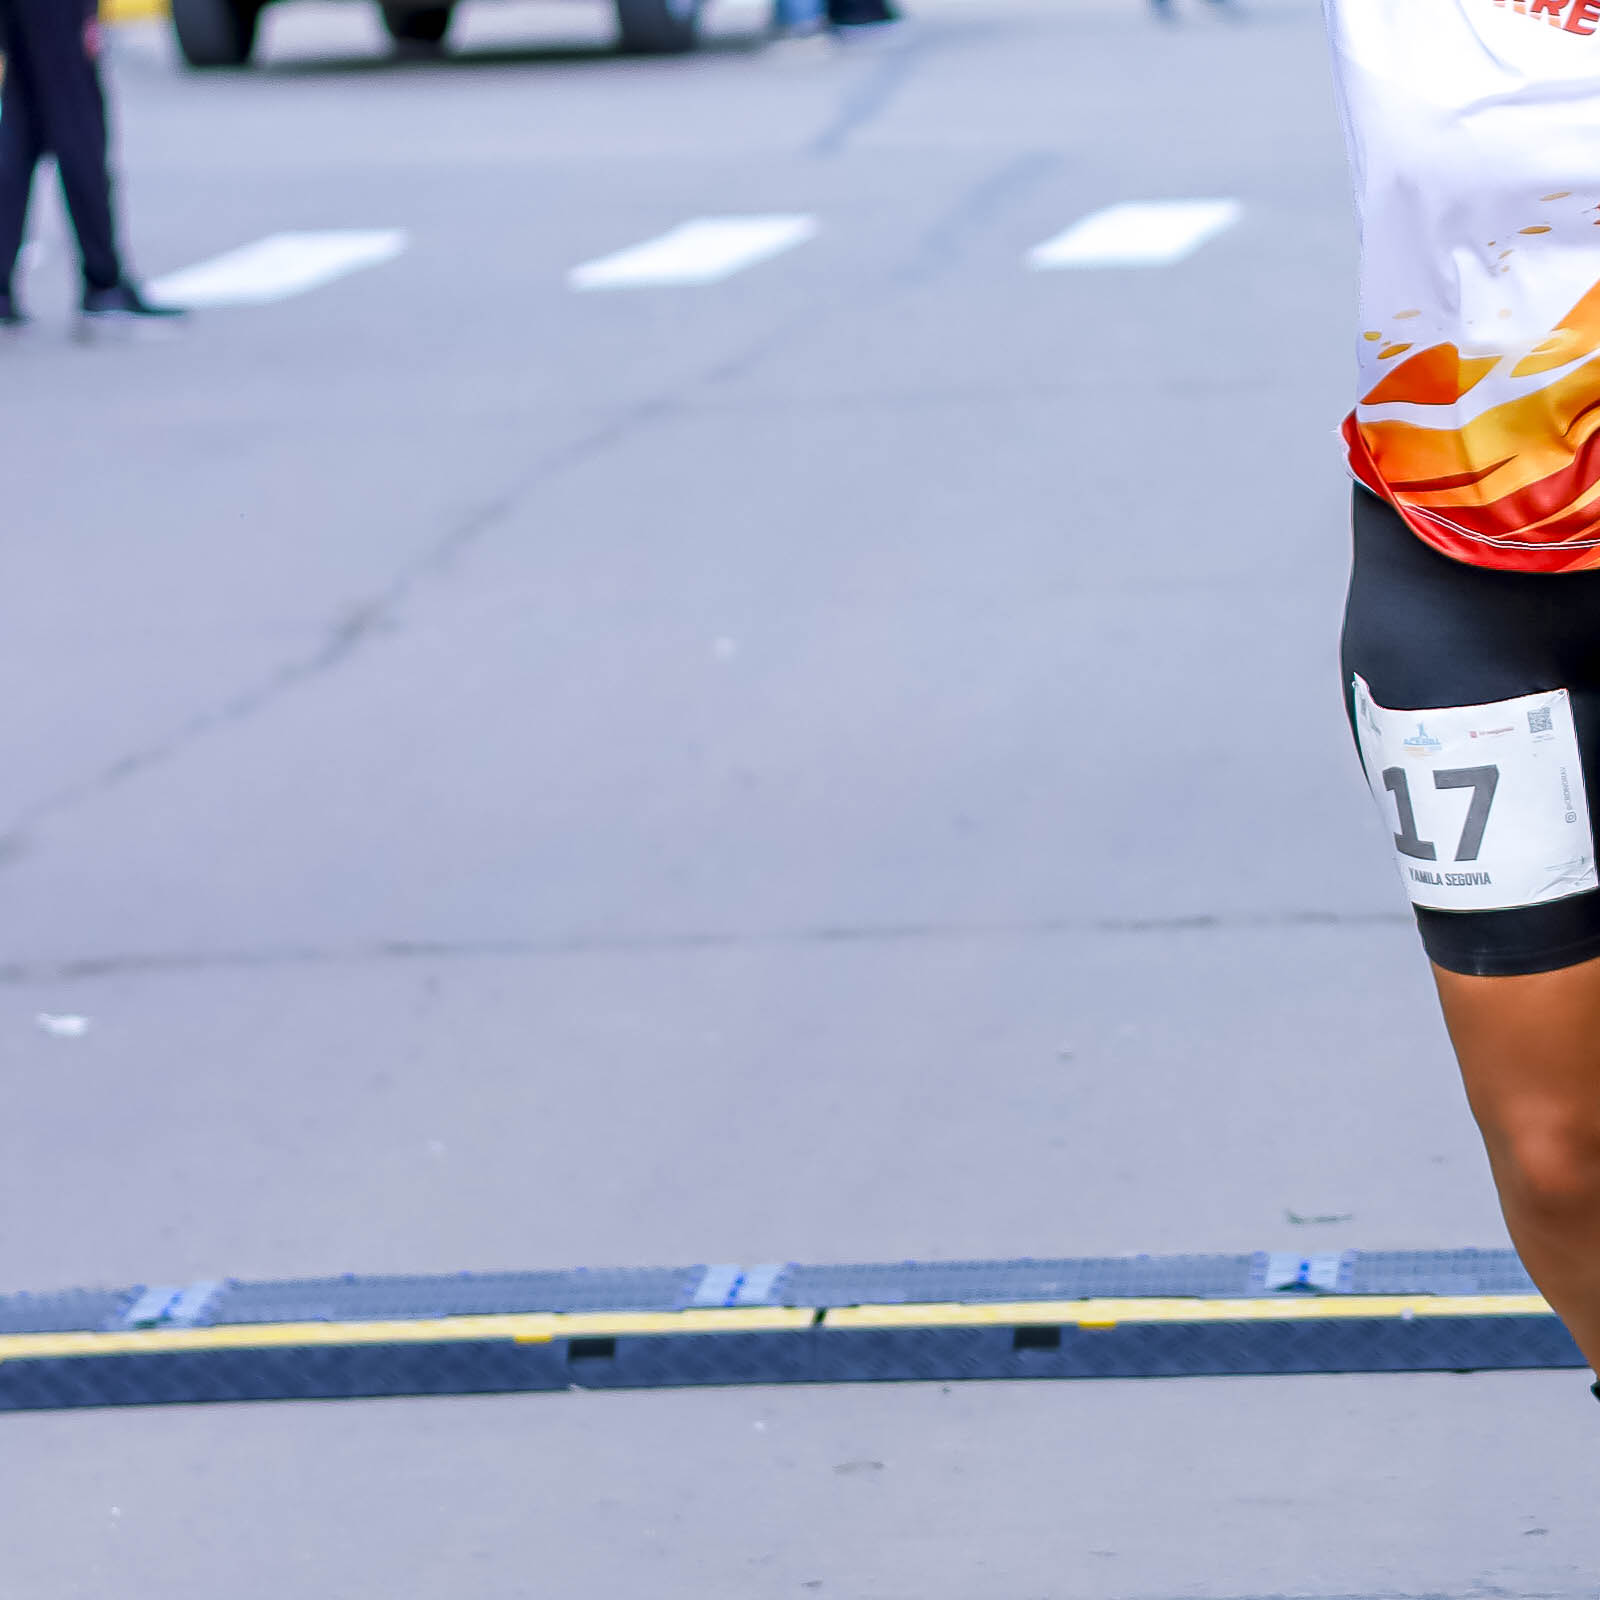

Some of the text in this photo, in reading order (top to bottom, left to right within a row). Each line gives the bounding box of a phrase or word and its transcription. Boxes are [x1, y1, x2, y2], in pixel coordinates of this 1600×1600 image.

[1382, 764, 1500, 862] 17
[1408, 866, 1492, 886] YAMILA SEGOVIA
